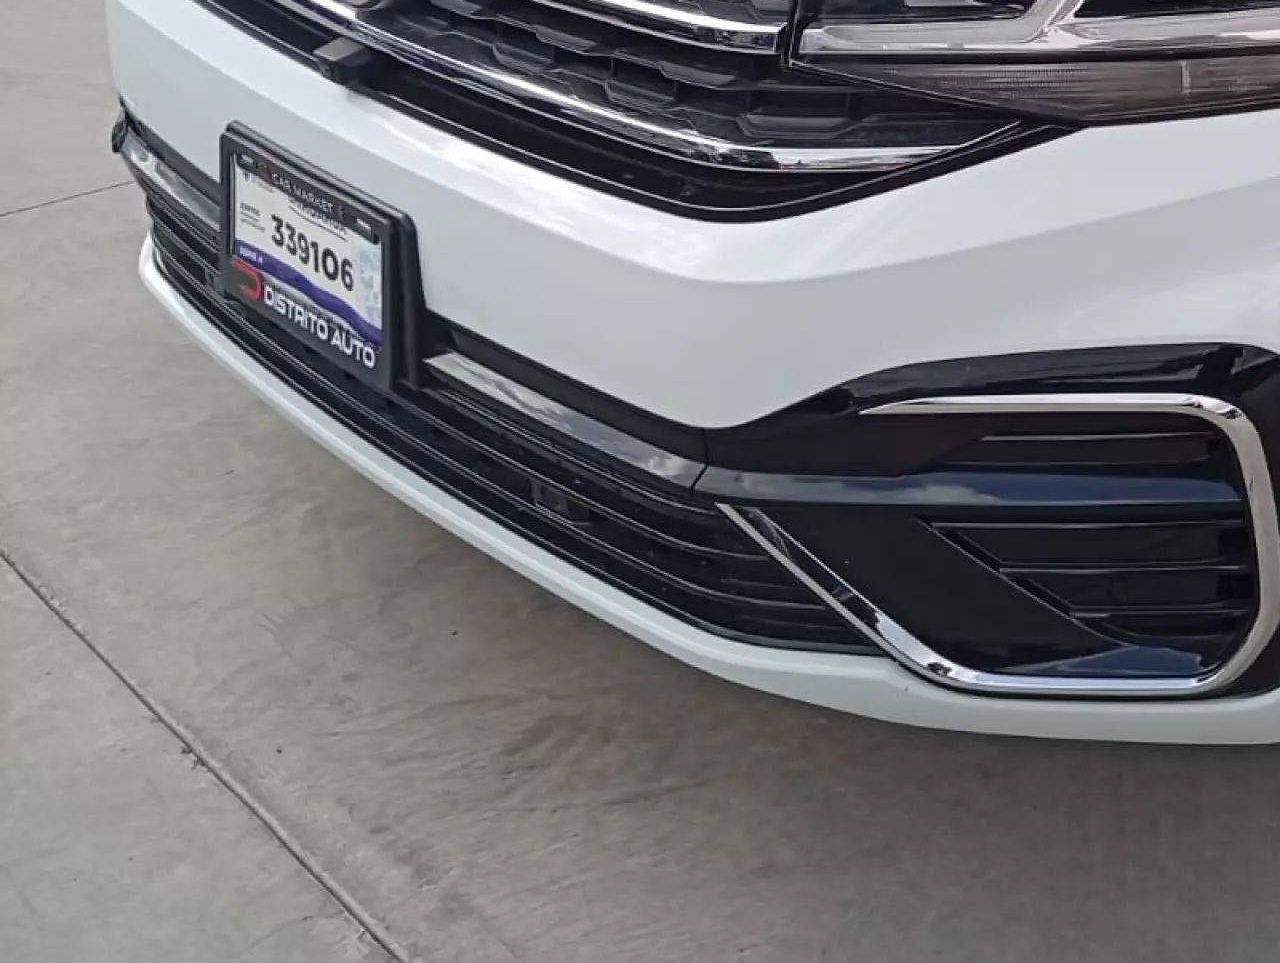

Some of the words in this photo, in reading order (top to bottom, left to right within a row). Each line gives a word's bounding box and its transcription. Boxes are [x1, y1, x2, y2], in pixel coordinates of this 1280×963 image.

[294, 184, 334, 214] MARKET
[271, 214, 353, 292] 339106
[263, 284, 329, 341] DISTRITO
[330, 326, 376, 369] AUTO
